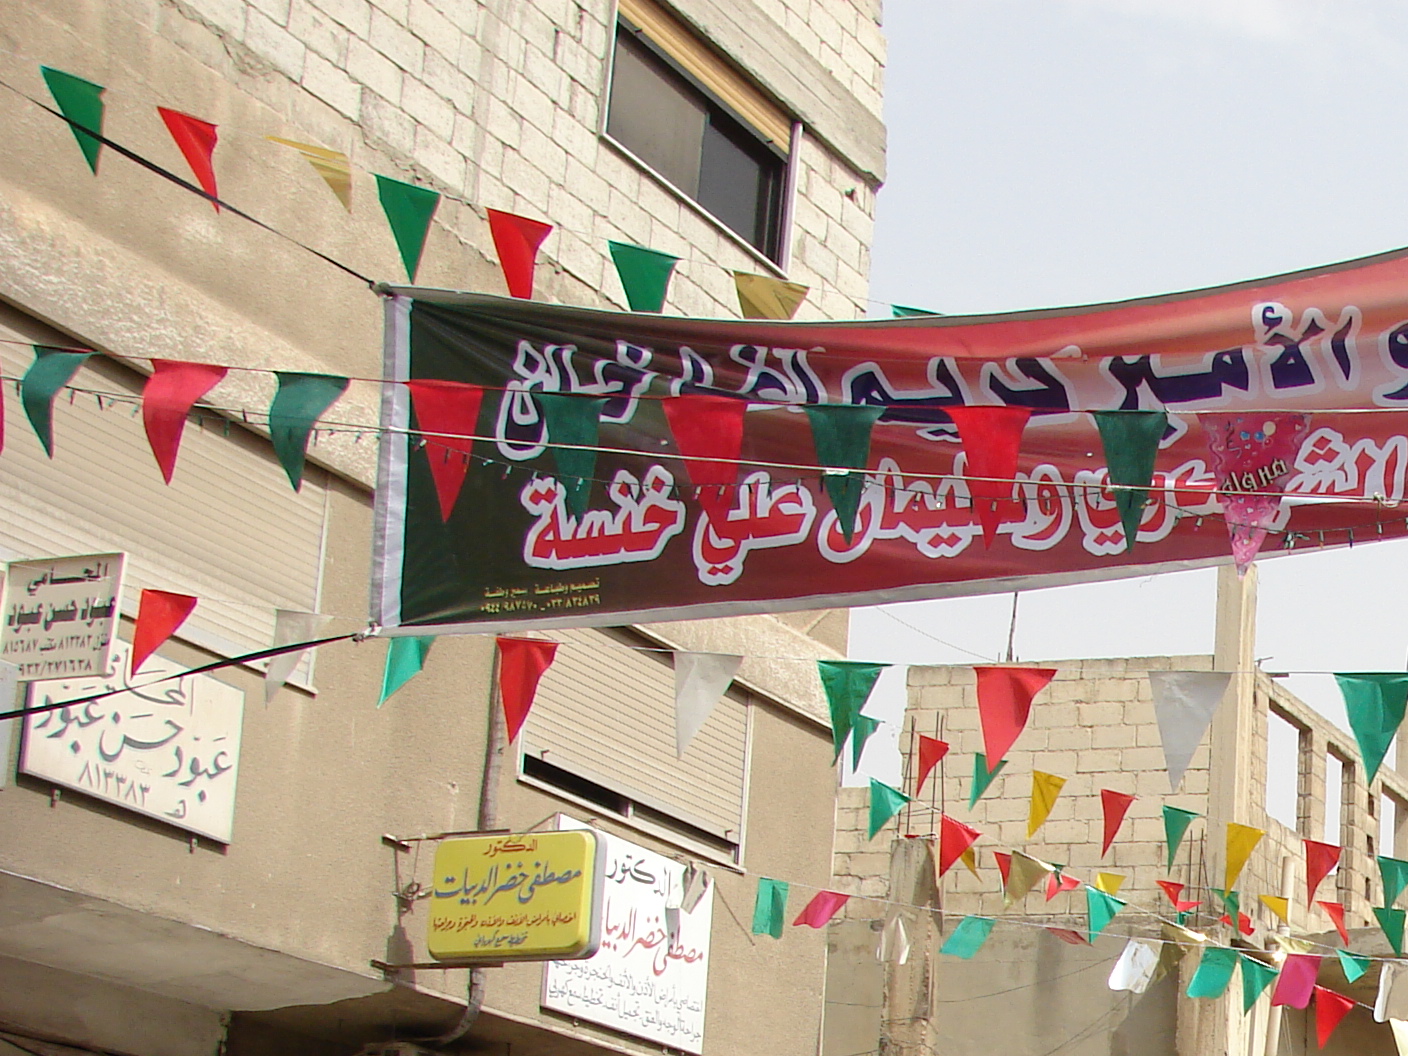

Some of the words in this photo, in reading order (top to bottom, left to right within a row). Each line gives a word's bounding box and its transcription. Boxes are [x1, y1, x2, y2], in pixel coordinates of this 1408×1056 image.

[8, 603, 42, 634] عبود
[44, 599, 77, 632] حسن
[100, 710, 183, 762] حسن
[483, 839, 537, 857] الدكتور
[605, 854, 671, 896] الدكتور
